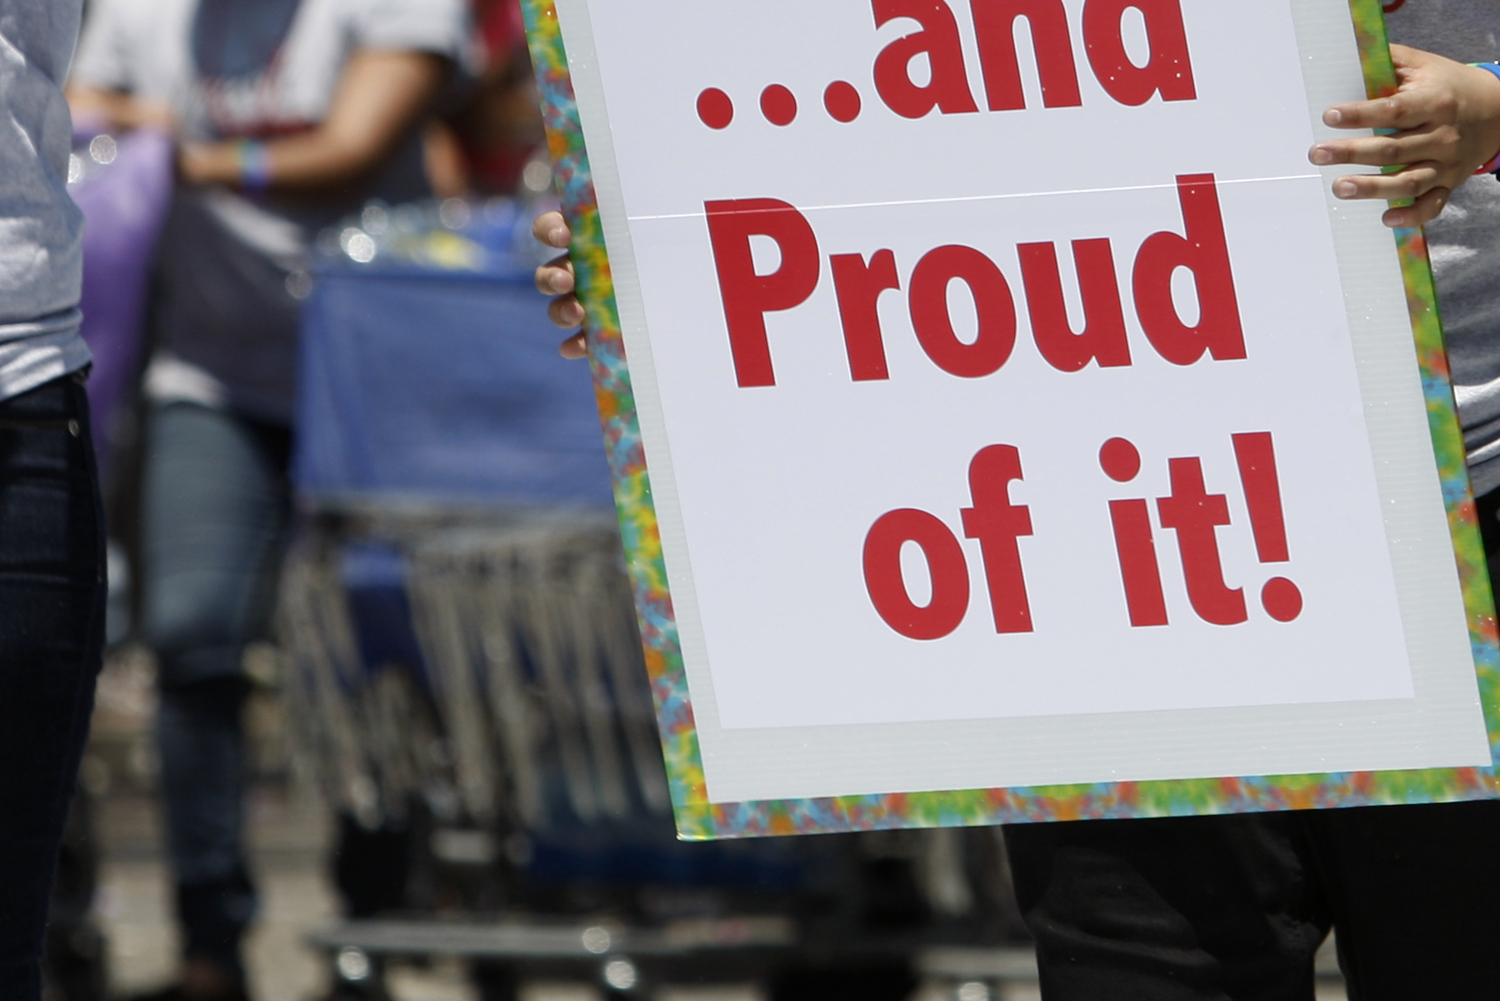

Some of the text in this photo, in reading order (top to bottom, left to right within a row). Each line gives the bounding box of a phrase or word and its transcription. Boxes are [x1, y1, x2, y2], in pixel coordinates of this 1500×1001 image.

[704, 172, 1248, 389] Proud
[863, 431, 1304, 641] of it!
